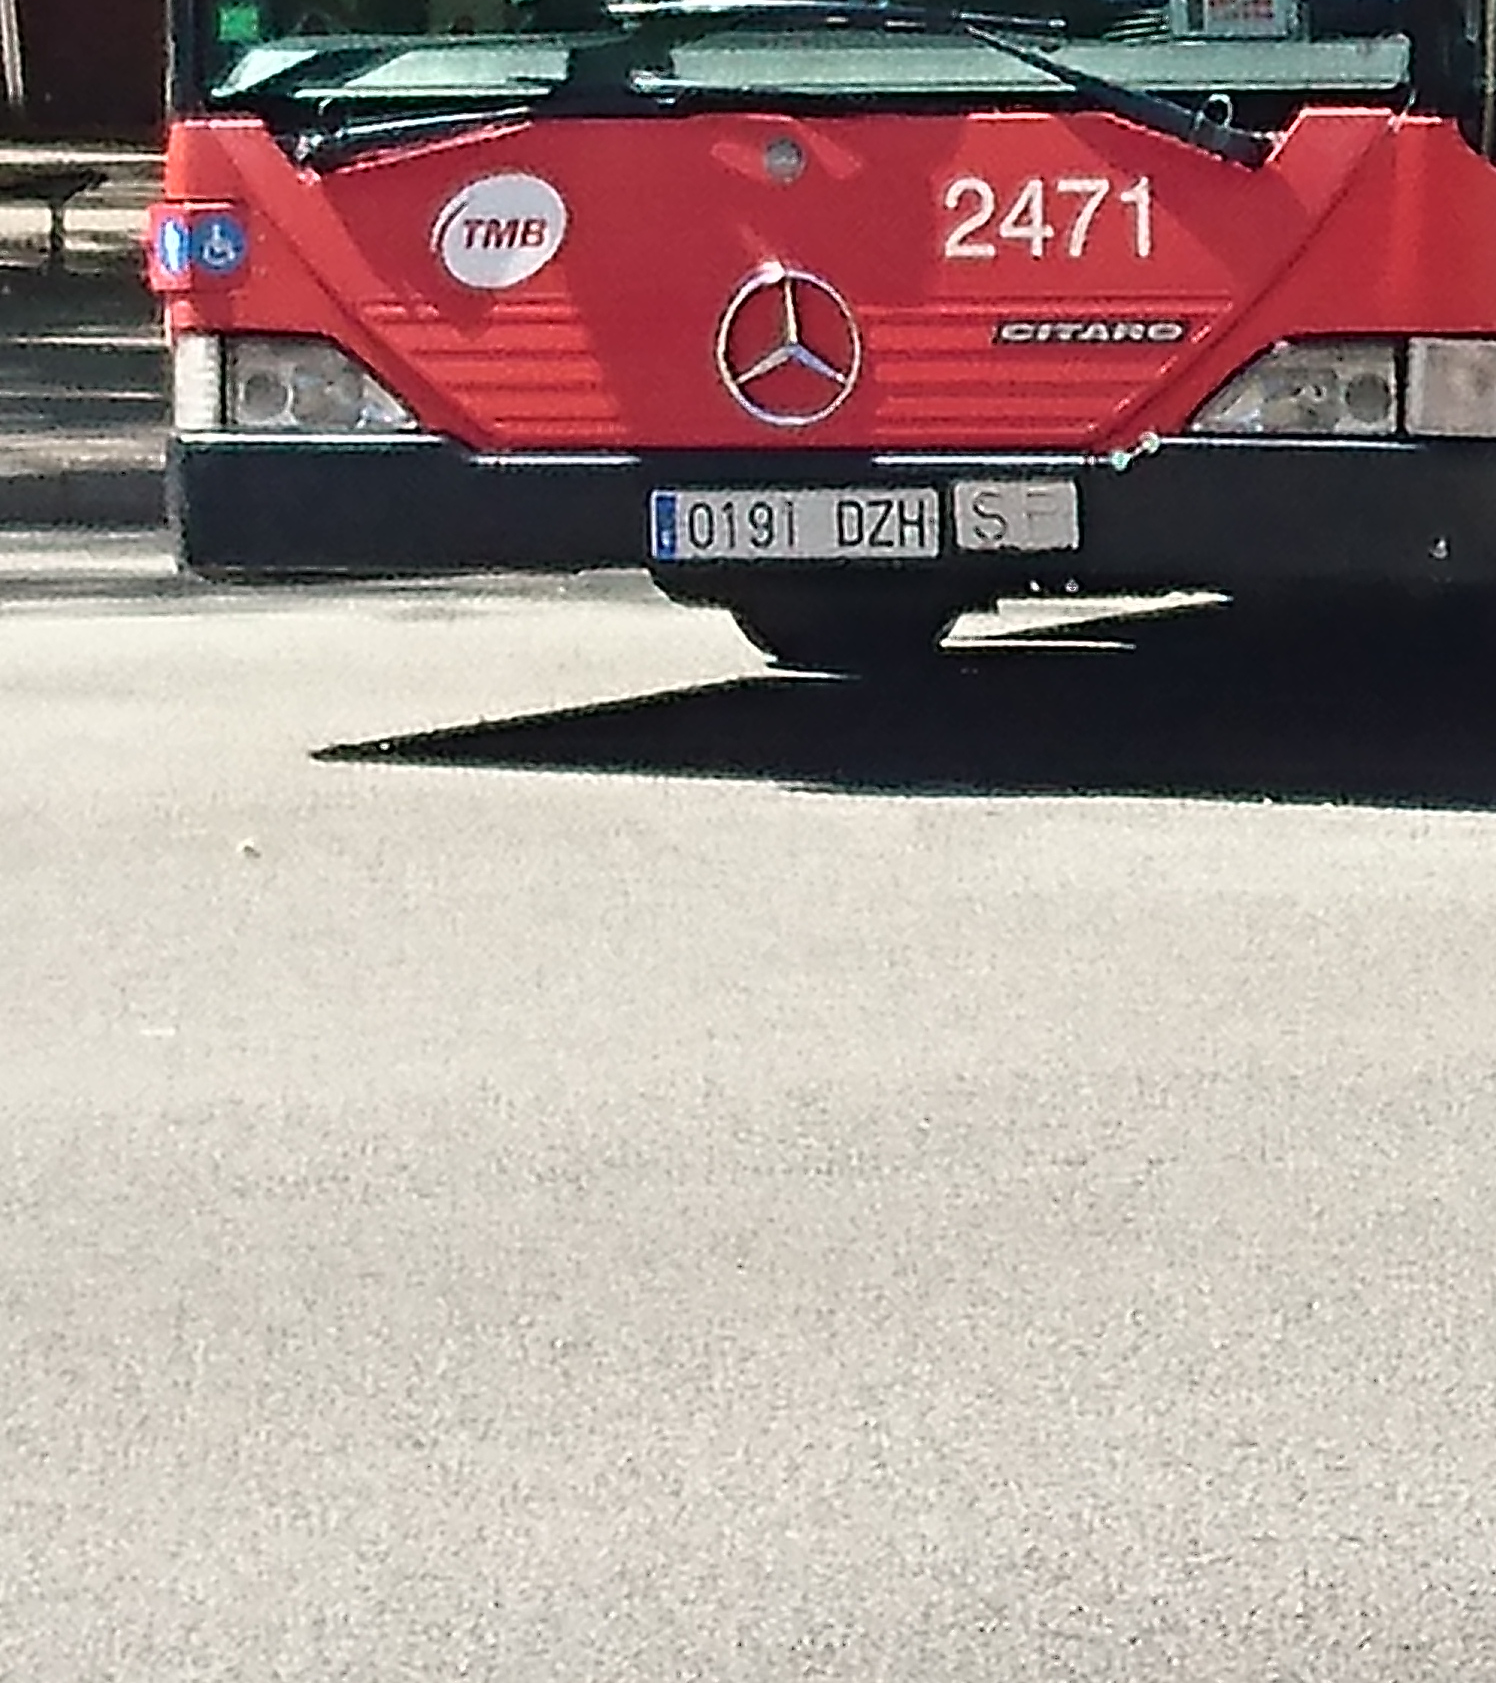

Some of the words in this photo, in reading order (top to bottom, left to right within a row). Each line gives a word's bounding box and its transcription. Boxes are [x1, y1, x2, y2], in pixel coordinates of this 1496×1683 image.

[463, 219, 547, 249] TMB
[944, 176, 1153, 257] 2471
[1001, 322, 1183, 341] CITARO
[688, 501, 798, 549] 0191
[837, 500, 926, 548] DZH
